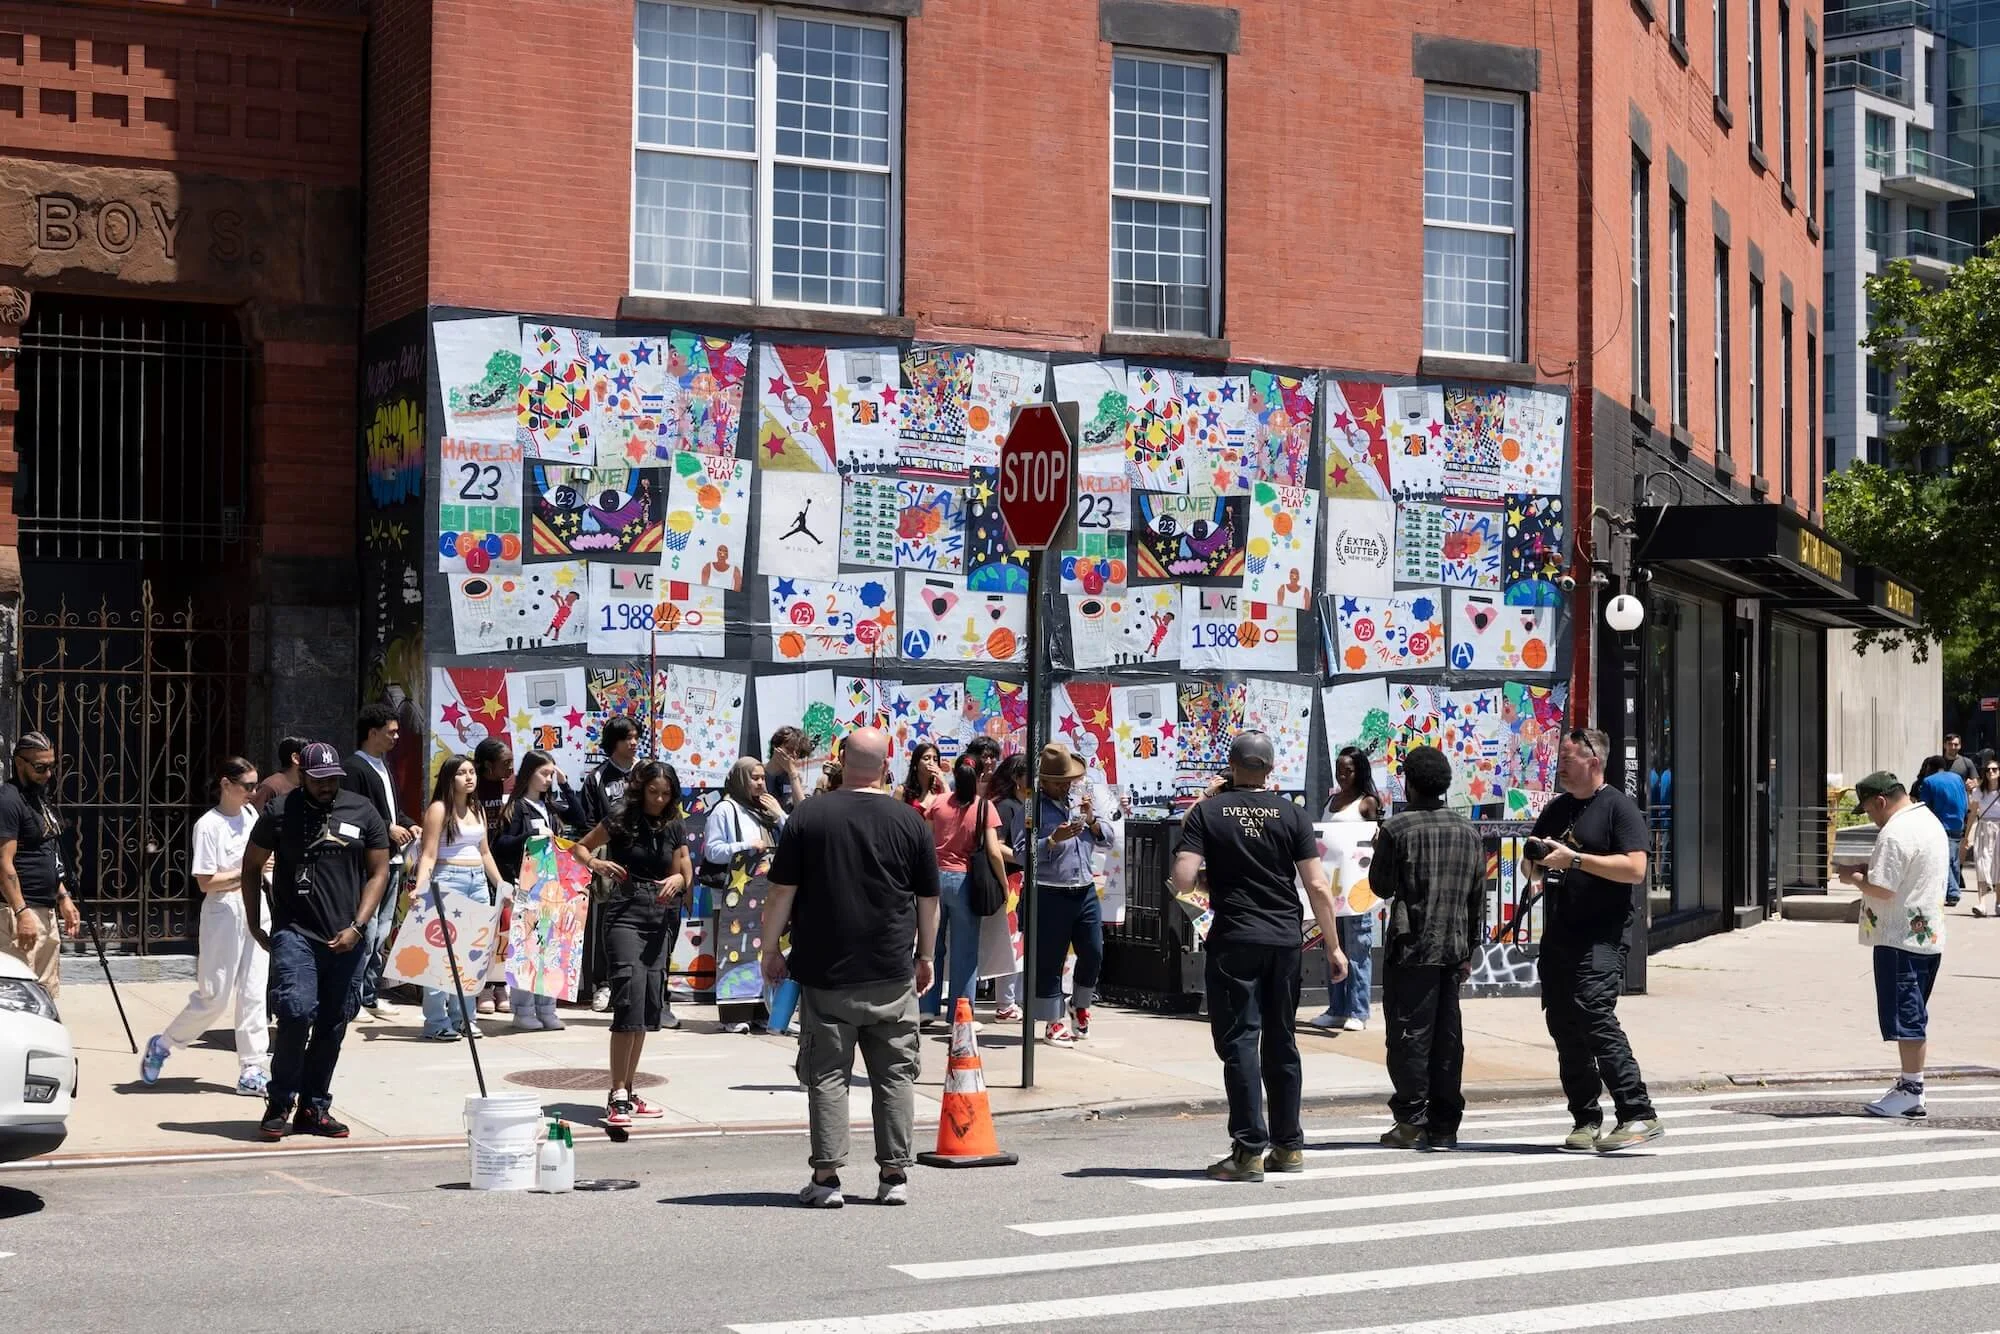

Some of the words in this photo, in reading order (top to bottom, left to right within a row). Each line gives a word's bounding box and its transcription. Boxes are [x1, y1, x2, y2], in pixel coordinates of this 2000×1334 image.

[442, 437, 524, 464] HARLEM
[704, 456, 739, 469] JUST
[708, 467, 733, 480] PLAY
[1004, 451, 1065, 502] STOP
[460, 463, 502, 500] 23
[1078, 473, 1130, 493] RLEM
[557, 491, 575, 506] 23
[1278, 485, 1308, 499] JUST
[1163, 495, 1211, 513] LOVE
[1282, 496, 1304, 508] PLAY
[1079, 493, 1112, 528] 23
[1159, 520, 1176, 534] 23
[1347, 536, 1377, 547] EXTRA
[1344, 545, 1380, 557] BUTTER
[601, 603, 655, 631] 1988
[907, 632, 926, 653] A
[1192, 623, 1239, 648] 1988
[1455, 642, 1472, 664] A
[1222, 807, 1280, 819] EVERYONE
[1240, 817, 1264, 828] CAN
[1244, 828, 1262, 838] FLY
